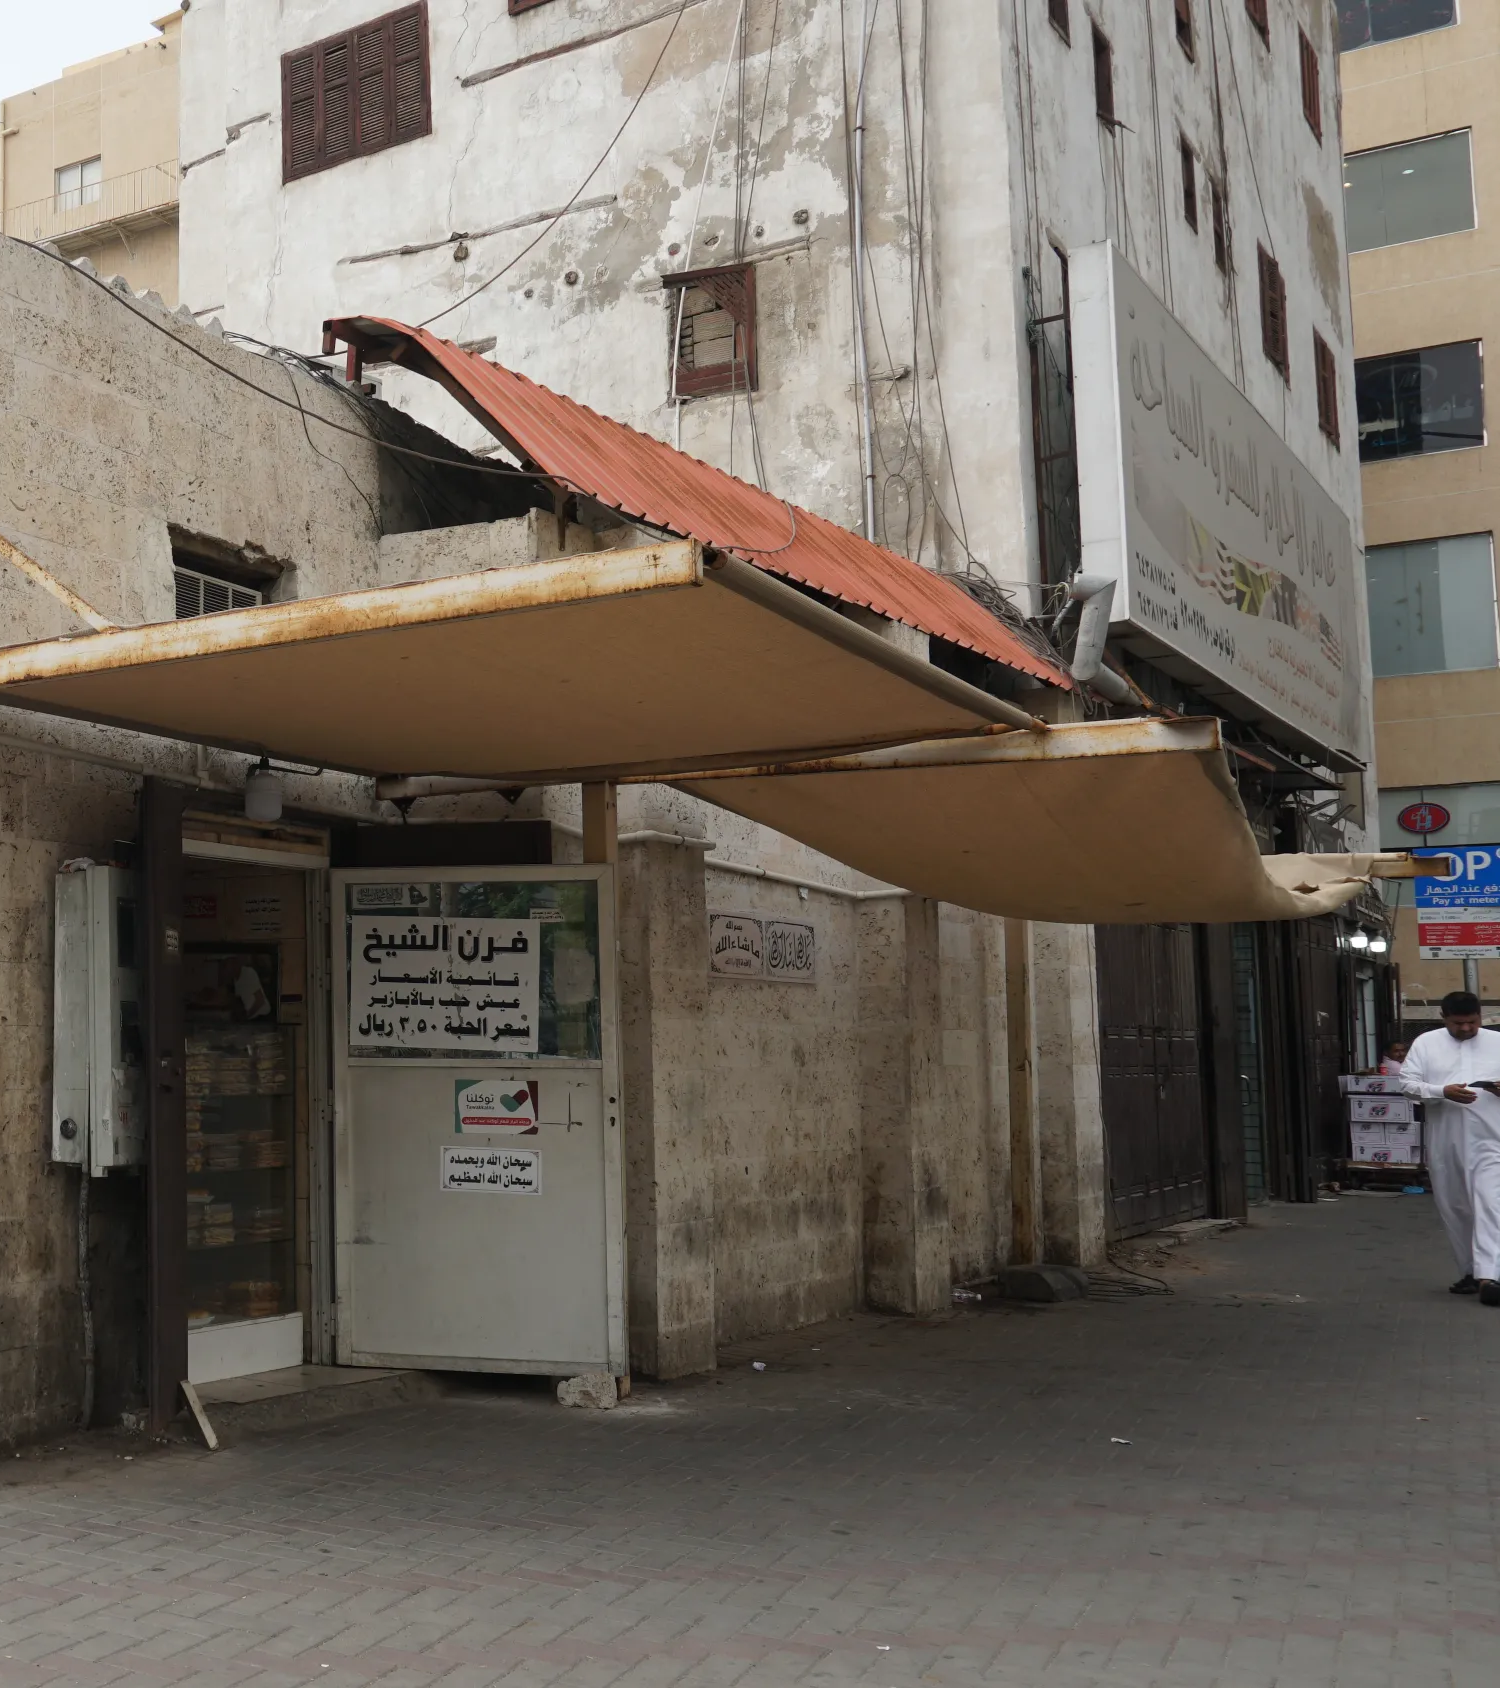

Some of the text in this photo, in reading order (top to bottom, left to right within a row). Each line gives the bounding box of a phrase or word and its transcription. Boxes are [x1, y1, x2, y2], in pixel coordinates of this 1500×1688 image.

[1424, 884, 1458, 896] الجهاز
[1460, 884, 1481, 893] عند
[1432, 896, 1499, 906] Pay at meter
[363, 923, 529, 963] فرن الشيخ
[369, 967, 520, 987] قائمة الأسعار
[366, 988, 520, 1011] عيش حب بالأبازير
[358, 1013, 393, 1037] ريال
[443, 1015, 486, 1040] الحبة
[489, 1022, 530, 1040] سعر
[466, 1092, 494, 1104] توكلنا
[450, 1153, 485, 1168] وبحمده
[486, 1151, 501, 1166] الله
[448, 1170, 533, 1189] سبحان الله العظيم
